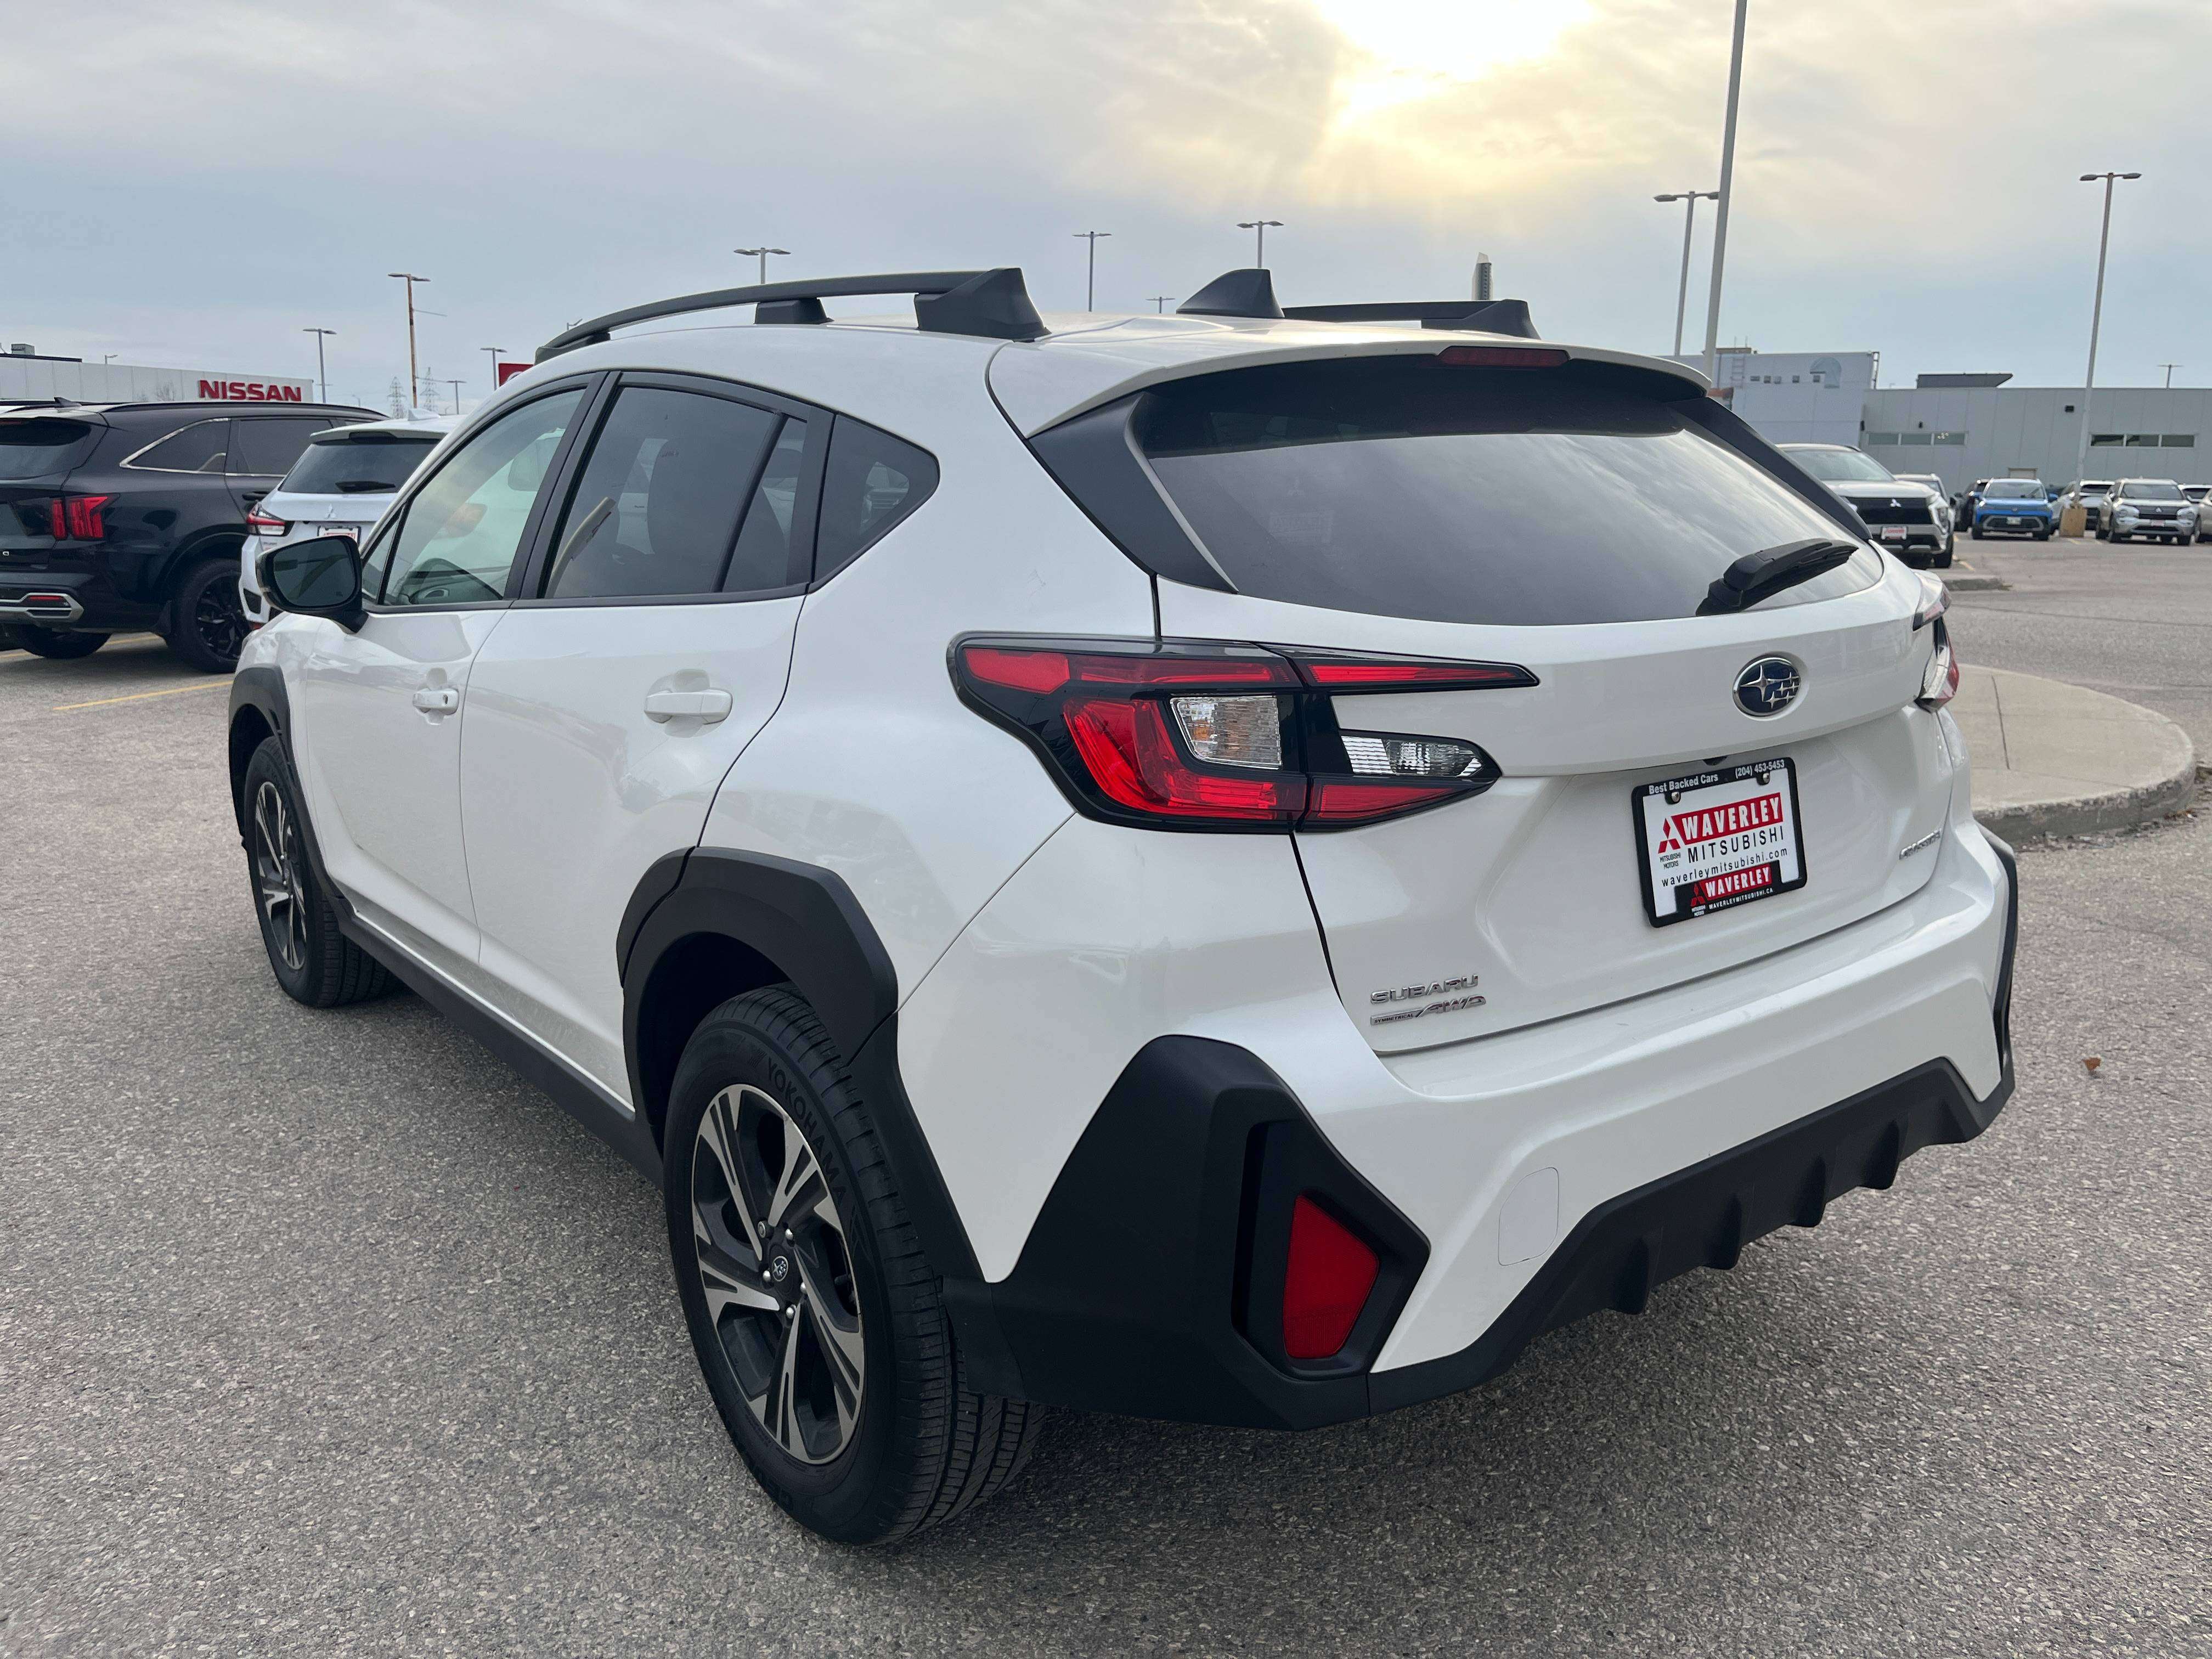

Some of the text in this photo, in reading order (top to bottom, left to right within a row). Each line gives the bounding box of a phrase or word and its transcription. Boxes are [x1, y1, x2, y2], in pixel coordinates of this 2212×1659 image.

[199, 380, 302, 402] NISSAN
[1649, 759, 1785, 794] Best Backed Cars (204) 453-5453
[1682, 797, 1781, 840] WAVERLEY
[1660, 853, 1681, 862] MITSUBISHI
[1688, 826, 1784, 864] MITSUBISHI
[1662, 848, 1788, 887] waverleymitsubishi.com
[1663, 861, 1679, 869] MOTORS
[1705, 866, 1770, 897] WAVERLEY
[1708, 887, 1773, 910] WAVERLEYMITSUBISHI.CA
[1370, 973, 1479, 1005] SUBARU
[1374, 994, 1487, 1024] SYMMETRICAL AWD
[768, 1057, 847, 1206] YOKOHAMA
